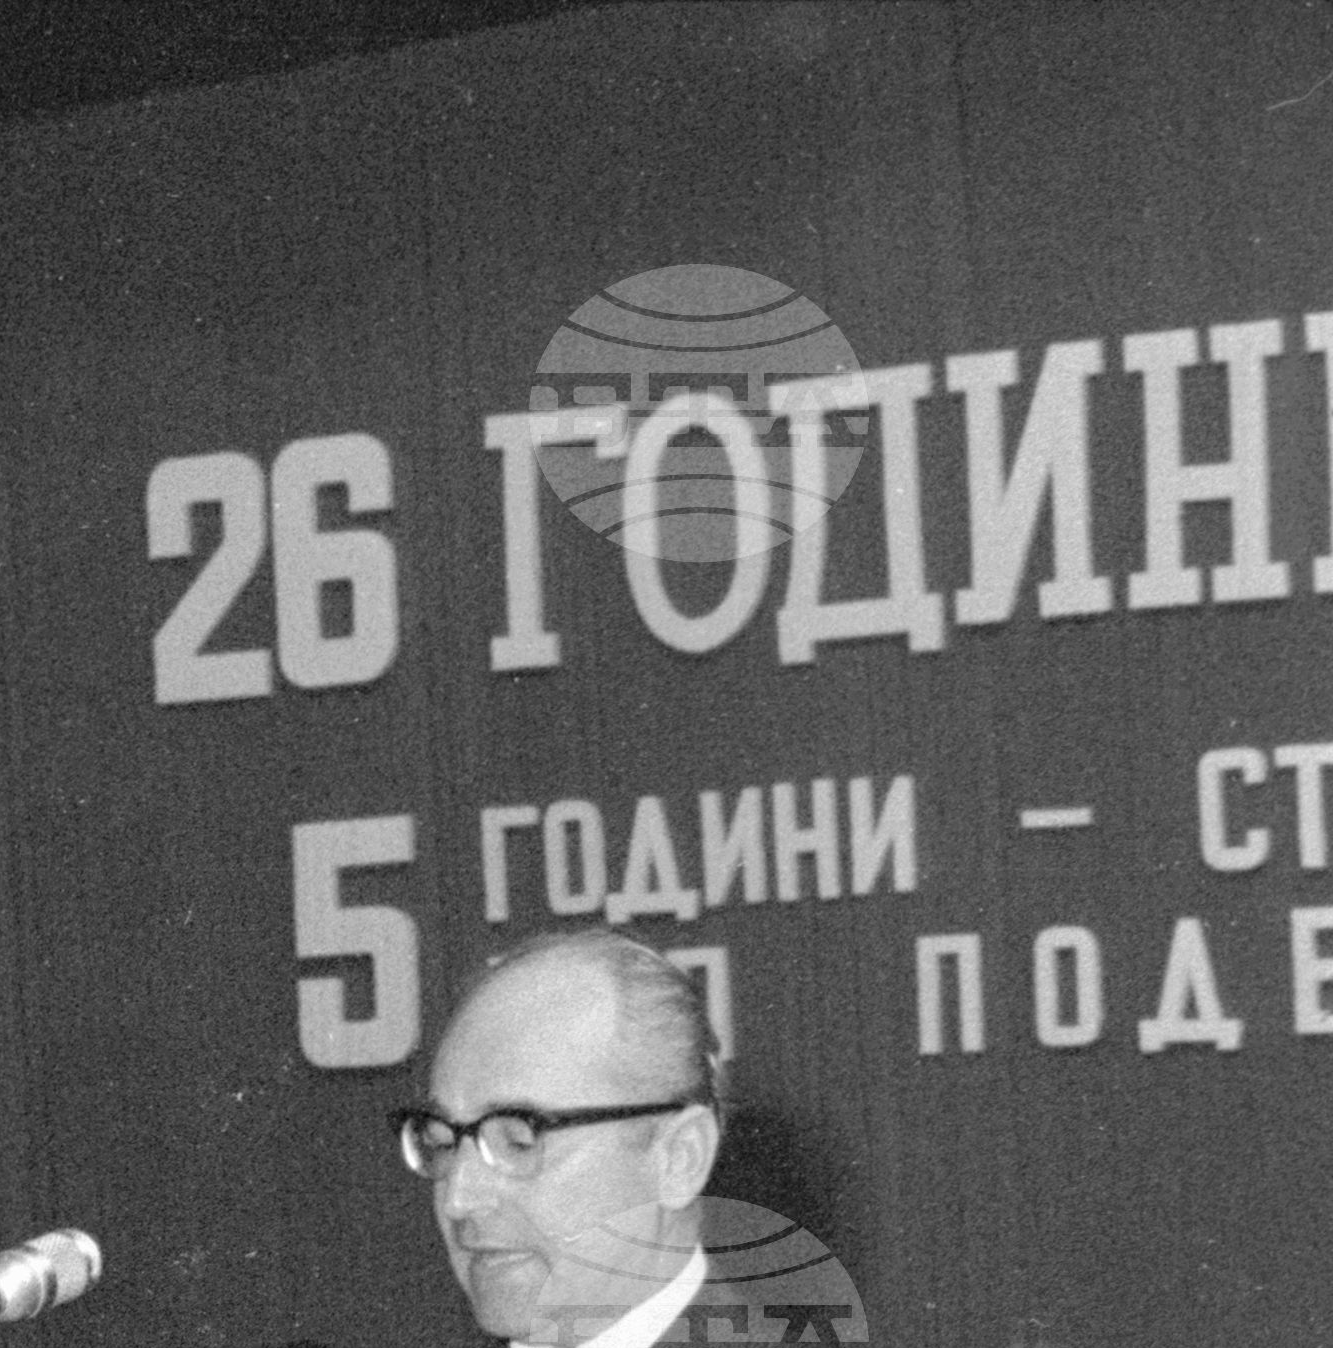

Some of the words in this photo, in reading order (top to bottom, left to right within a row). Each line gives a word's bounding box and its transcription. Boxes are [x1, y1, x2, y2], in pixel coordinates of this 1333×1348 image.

[146, 432, 399, 703] 26
[483, 311, 1333, 672] ГОДИН
[292, 814, 421, 1068] 5
[480, 774, 917, 924] ГОДИНИ
